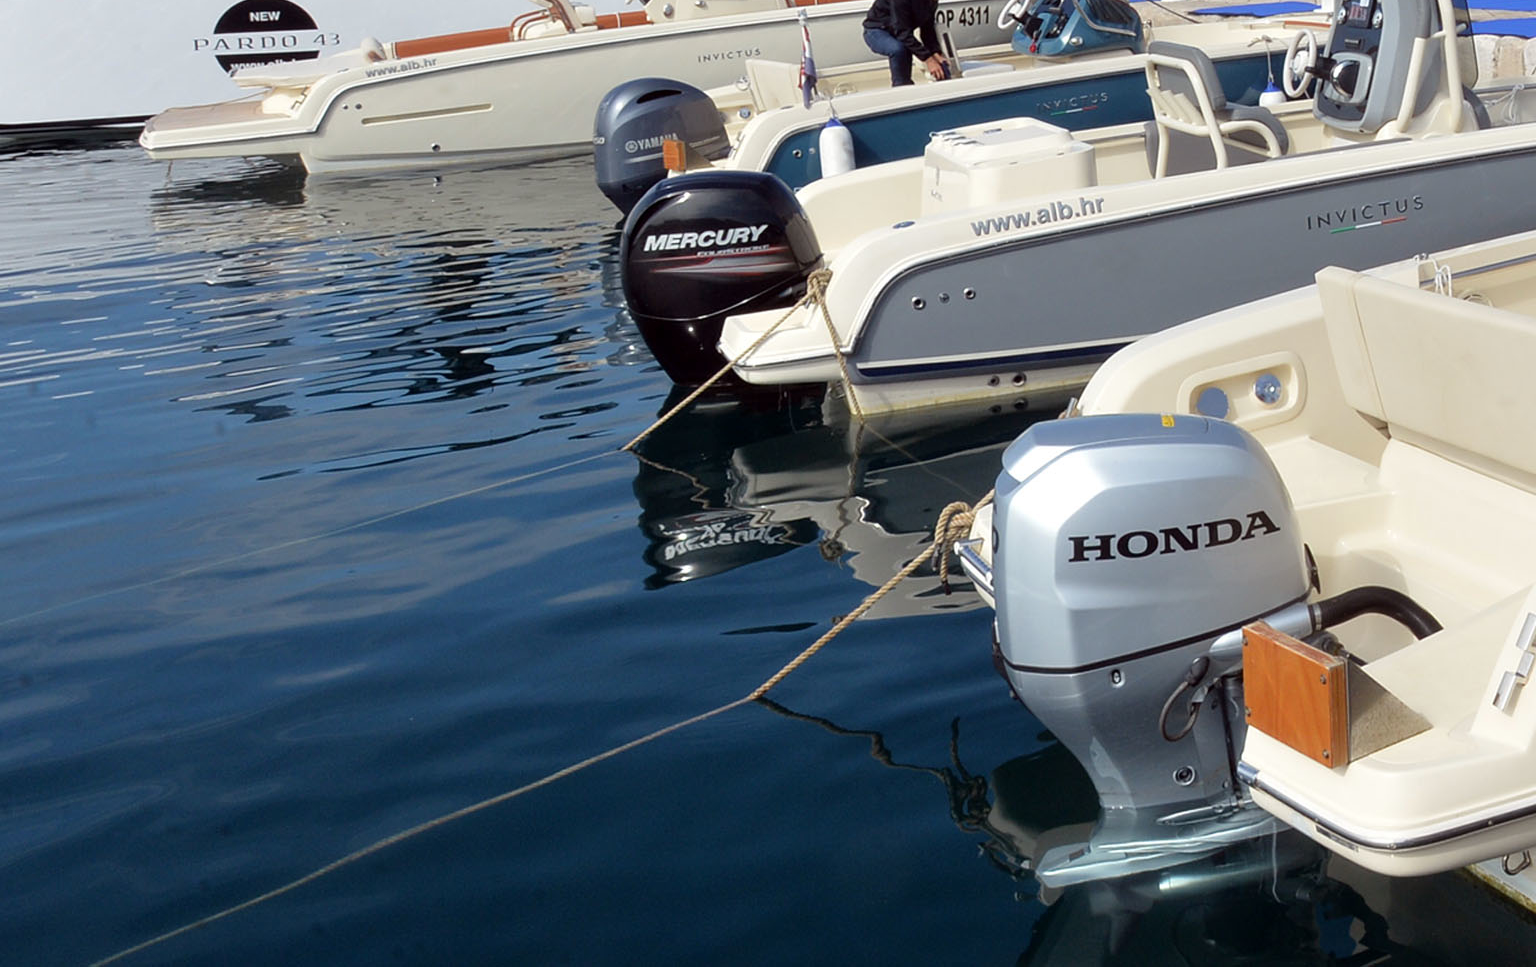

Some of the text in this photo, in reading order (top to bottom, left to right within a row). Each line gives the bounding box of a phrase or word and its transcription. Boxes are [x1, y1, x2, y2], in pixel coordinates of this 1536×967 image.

[249, 11, 281, 22] NEW
[959, 5, 990, 27] 4311
[193, 33, 341, 51] PARDO 43
[697, 48, 762, 63] INVICTUS
[365, 57, 438, 78] www.alb.hr
[1036, 92, 1109, 111] INVICTUS
[970, 196, 1105, 237] www.alb.hr
[1307, 194, 1424, 230] INVICTUS
[644, 224, 769, 252] MERCURY
[1068, 510, 1281, 563] HONDA
